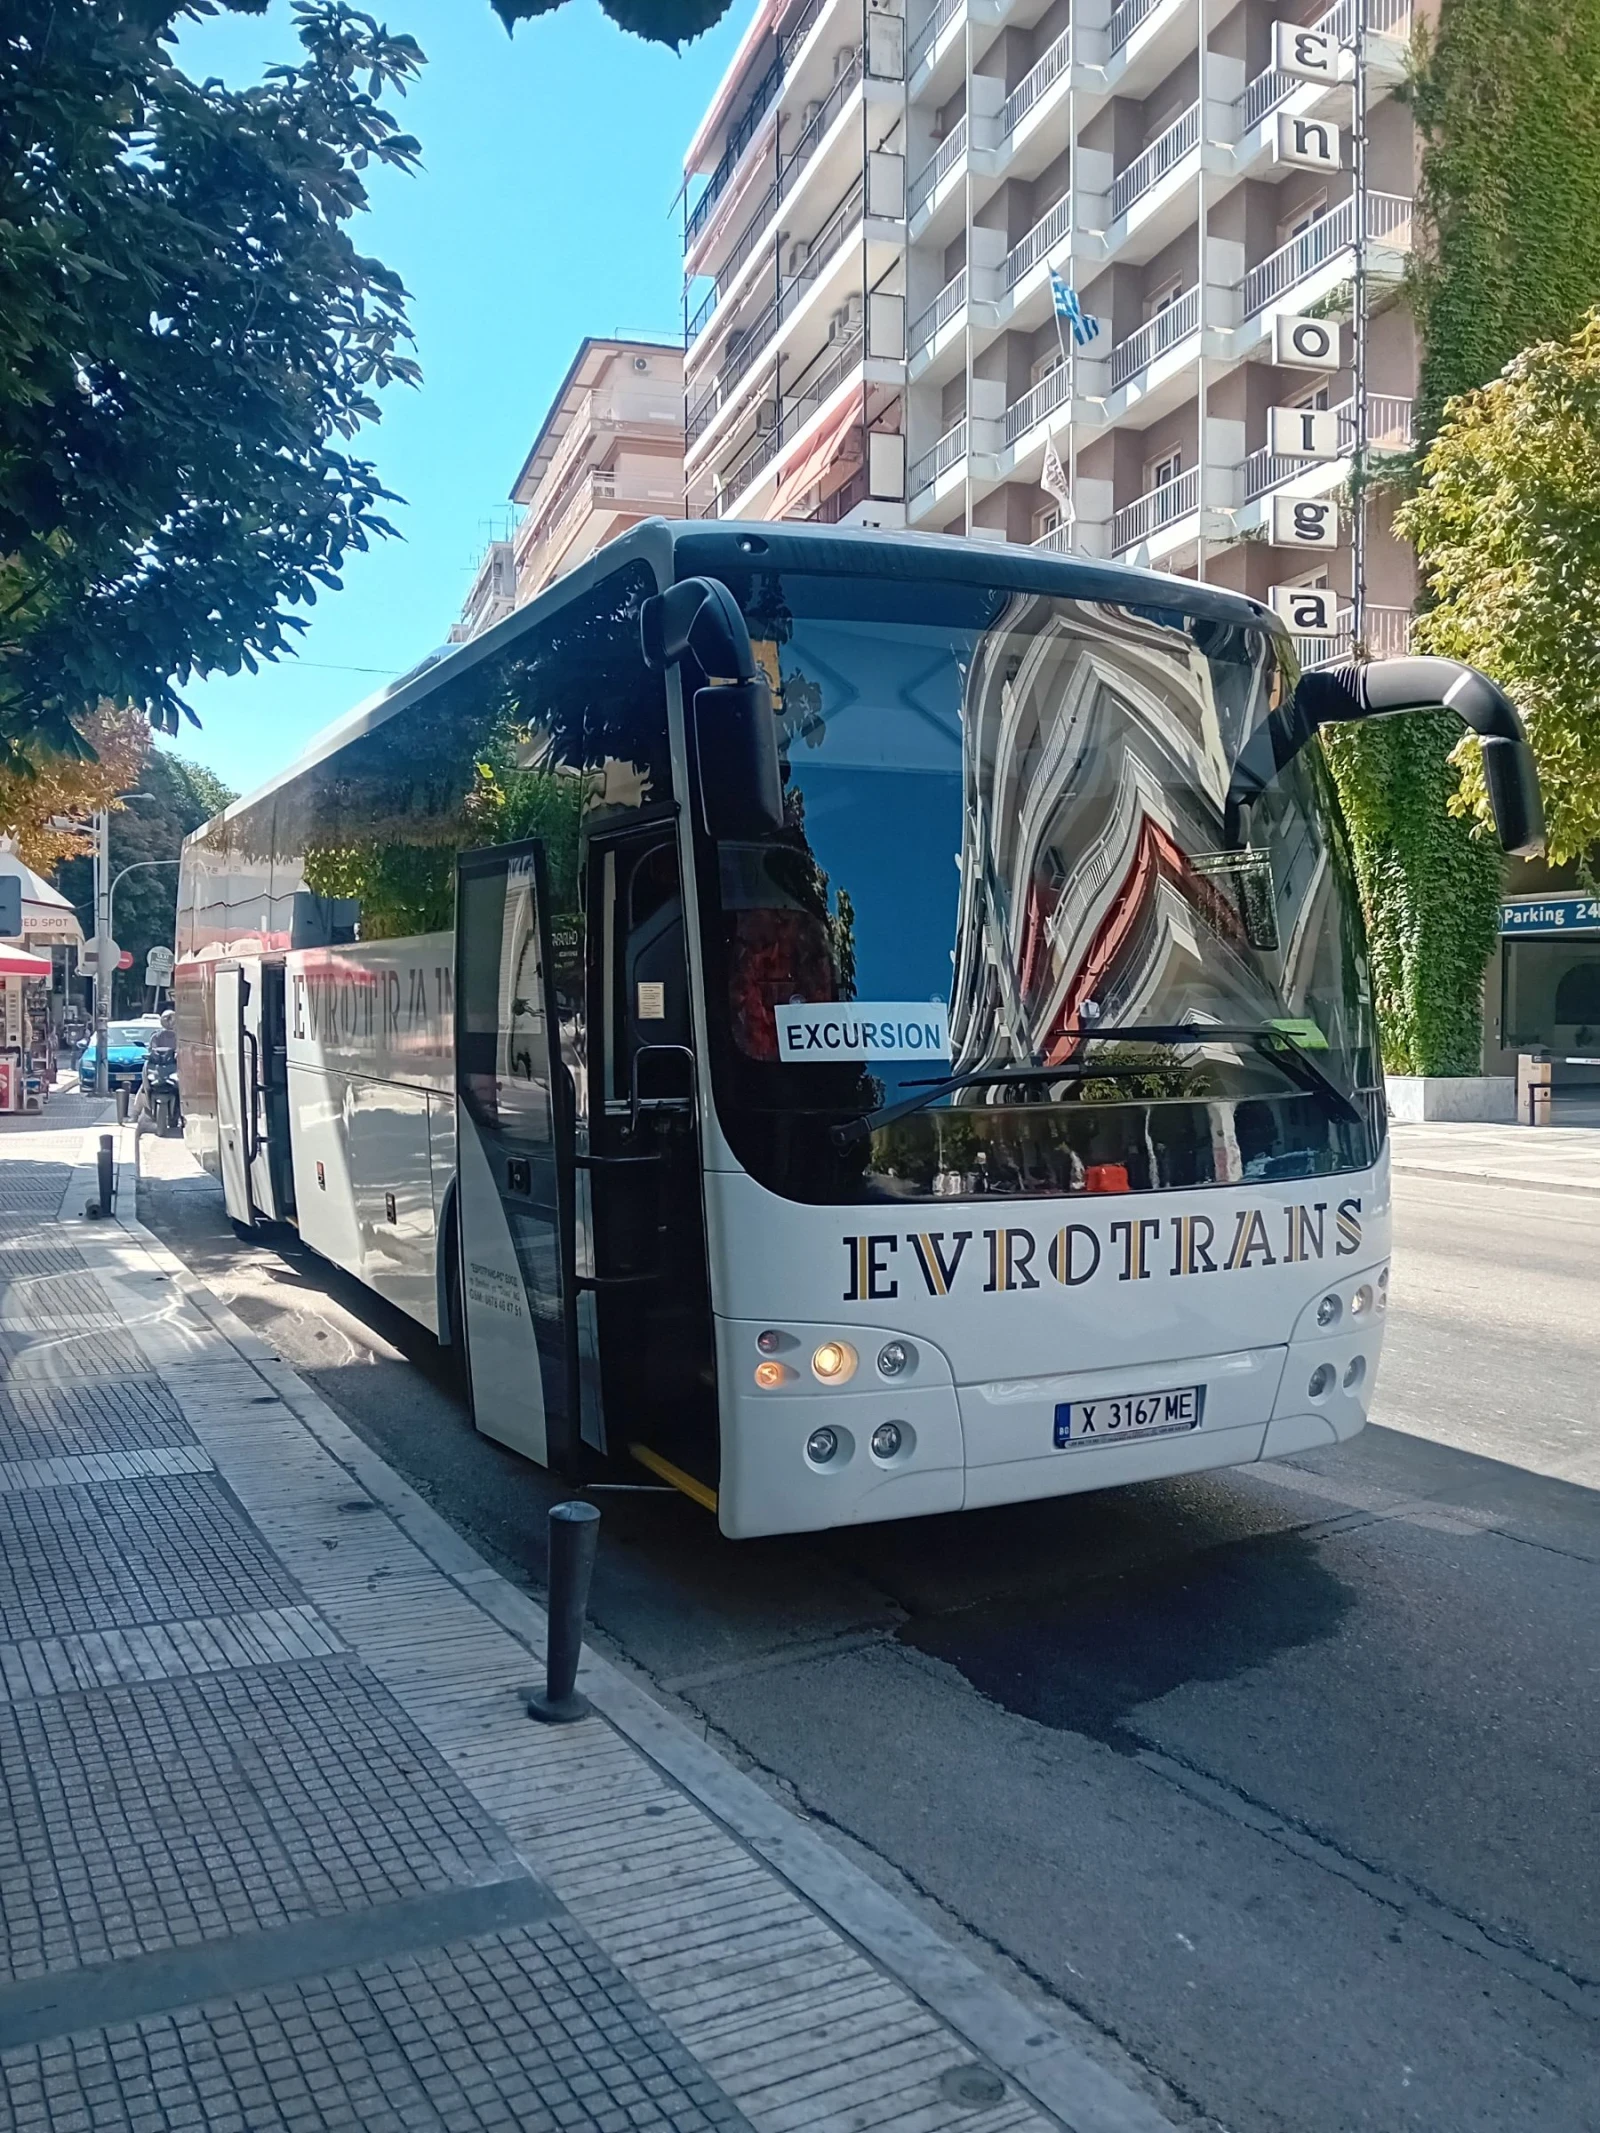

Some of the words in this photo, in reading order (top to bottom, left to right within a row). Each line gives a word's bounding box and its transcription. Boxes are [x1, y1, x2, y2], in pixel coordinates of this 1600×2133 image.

[21, 918, 38, 928] ED
[41, 918, 68, 927] SPOT
[1504, 906, 1565, 926] Parking
[1576, 902, 1600, 919] 24
[787, 1022, 941, 1051] EXCURSION
[842, 1198, 1362, 1301] EVROTRANS
[1059, 1426, 1070, 1436] BG
[1082, 1406, 1096, 1433] X
[1108, 1398, 1161, 1429] 3167
